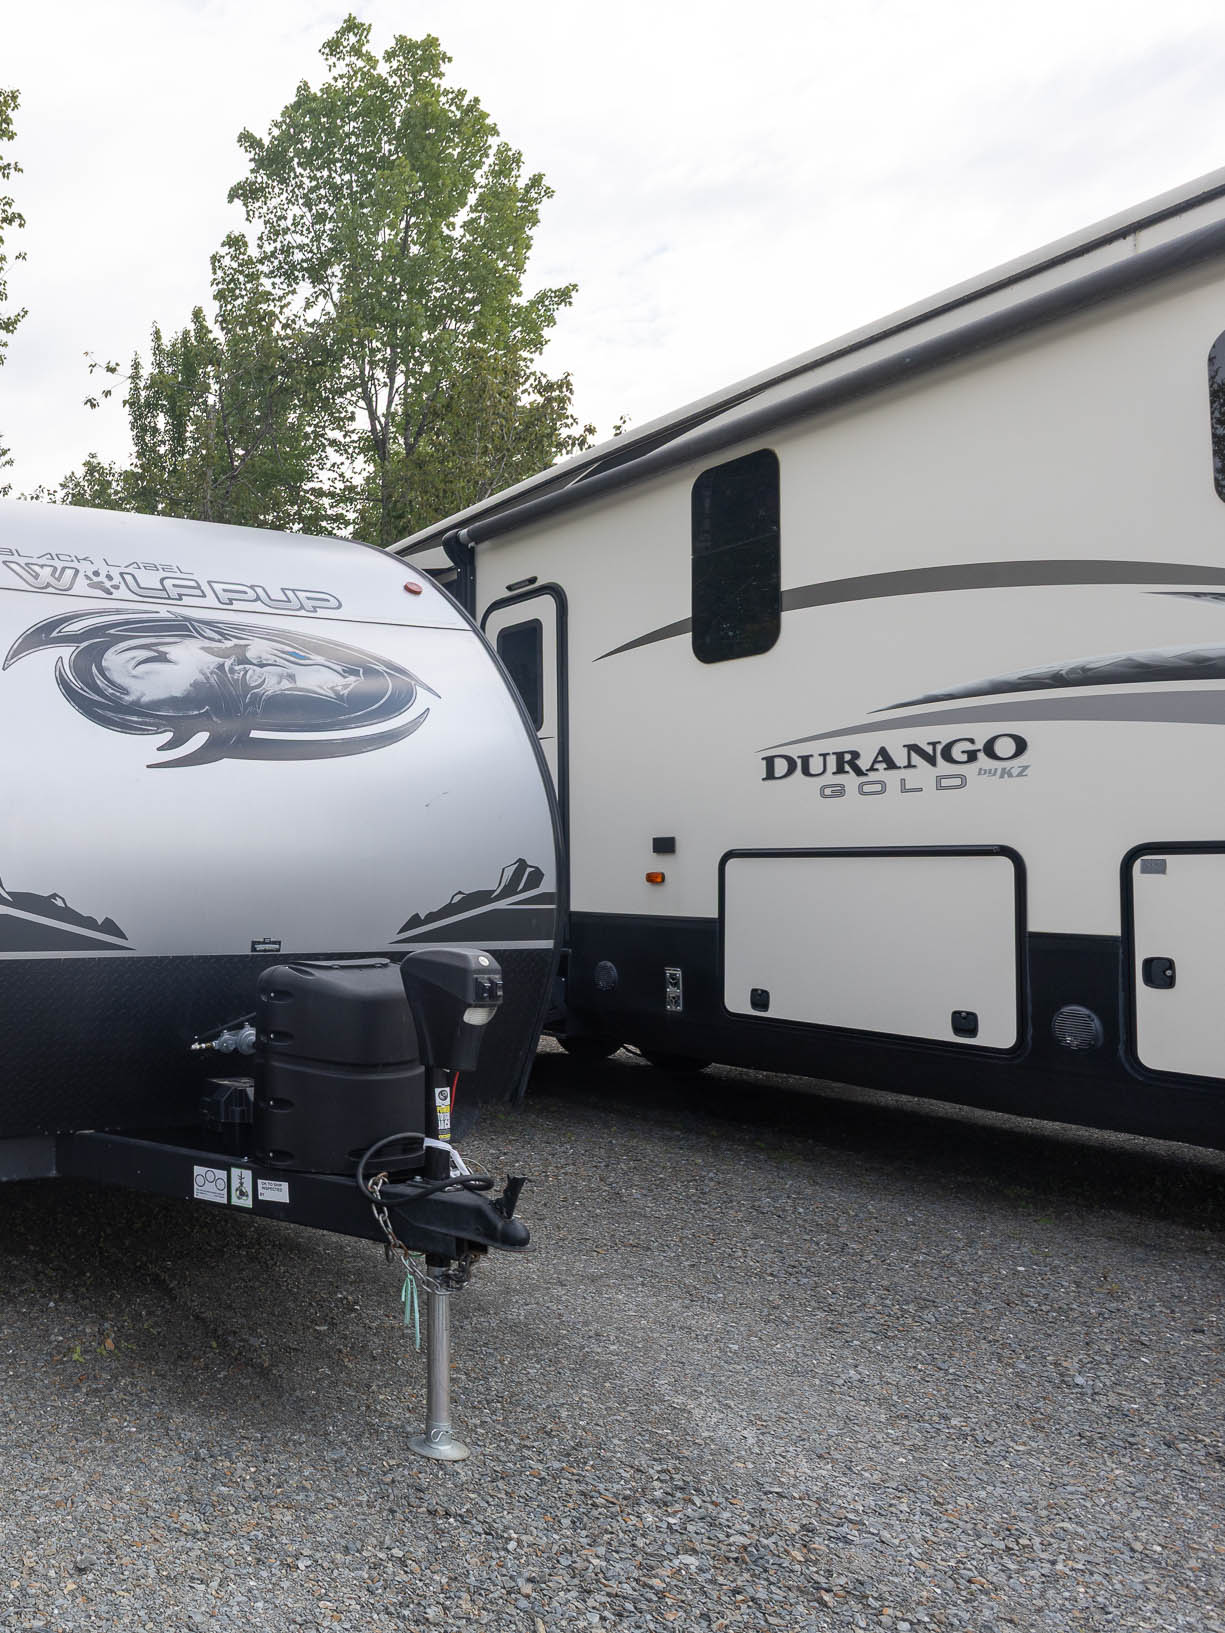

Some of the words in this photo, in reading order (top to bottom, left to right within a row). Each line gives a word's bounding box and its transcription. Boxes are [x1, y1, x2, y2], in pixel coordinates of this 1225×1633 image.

[103, 558, 194, 575] LABEL
[760, 733, 1029, 782] DURANGO
[819, 773, 967, 799] GOLD
